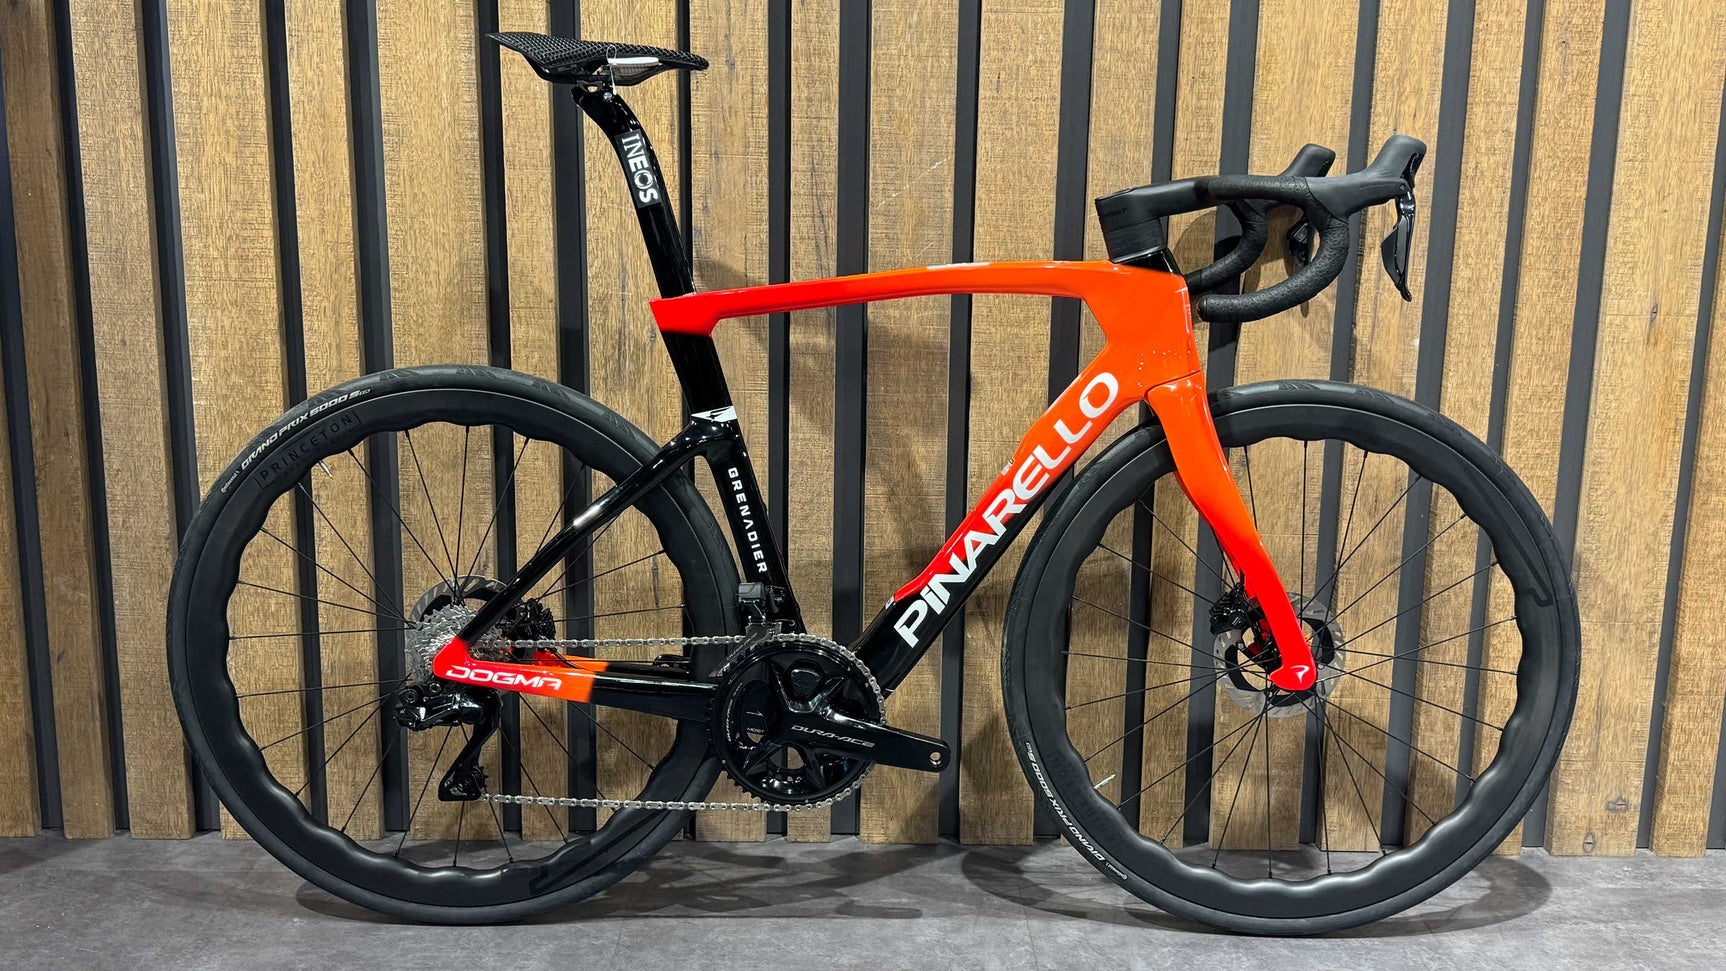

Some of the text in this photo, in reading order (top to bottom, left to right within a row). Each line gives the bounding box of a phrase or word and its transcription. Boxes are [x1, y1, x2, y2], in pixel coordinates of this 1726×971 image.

[621, 133, 659, 203] INEOS
[278, 413, 309, 438] PRIX
[309, 394, 349, 418] 5000
[259, 414, 353, 481] PRINCETON
[727, 466, 768, 573] GRENADIER
[445, 664, 562, 690] DOGMA
[791, 724, 876, 748] DURA-ACE
[1031, 761, 1053, 799] 5000
[1049, 799, 1071, 827] PRIX
